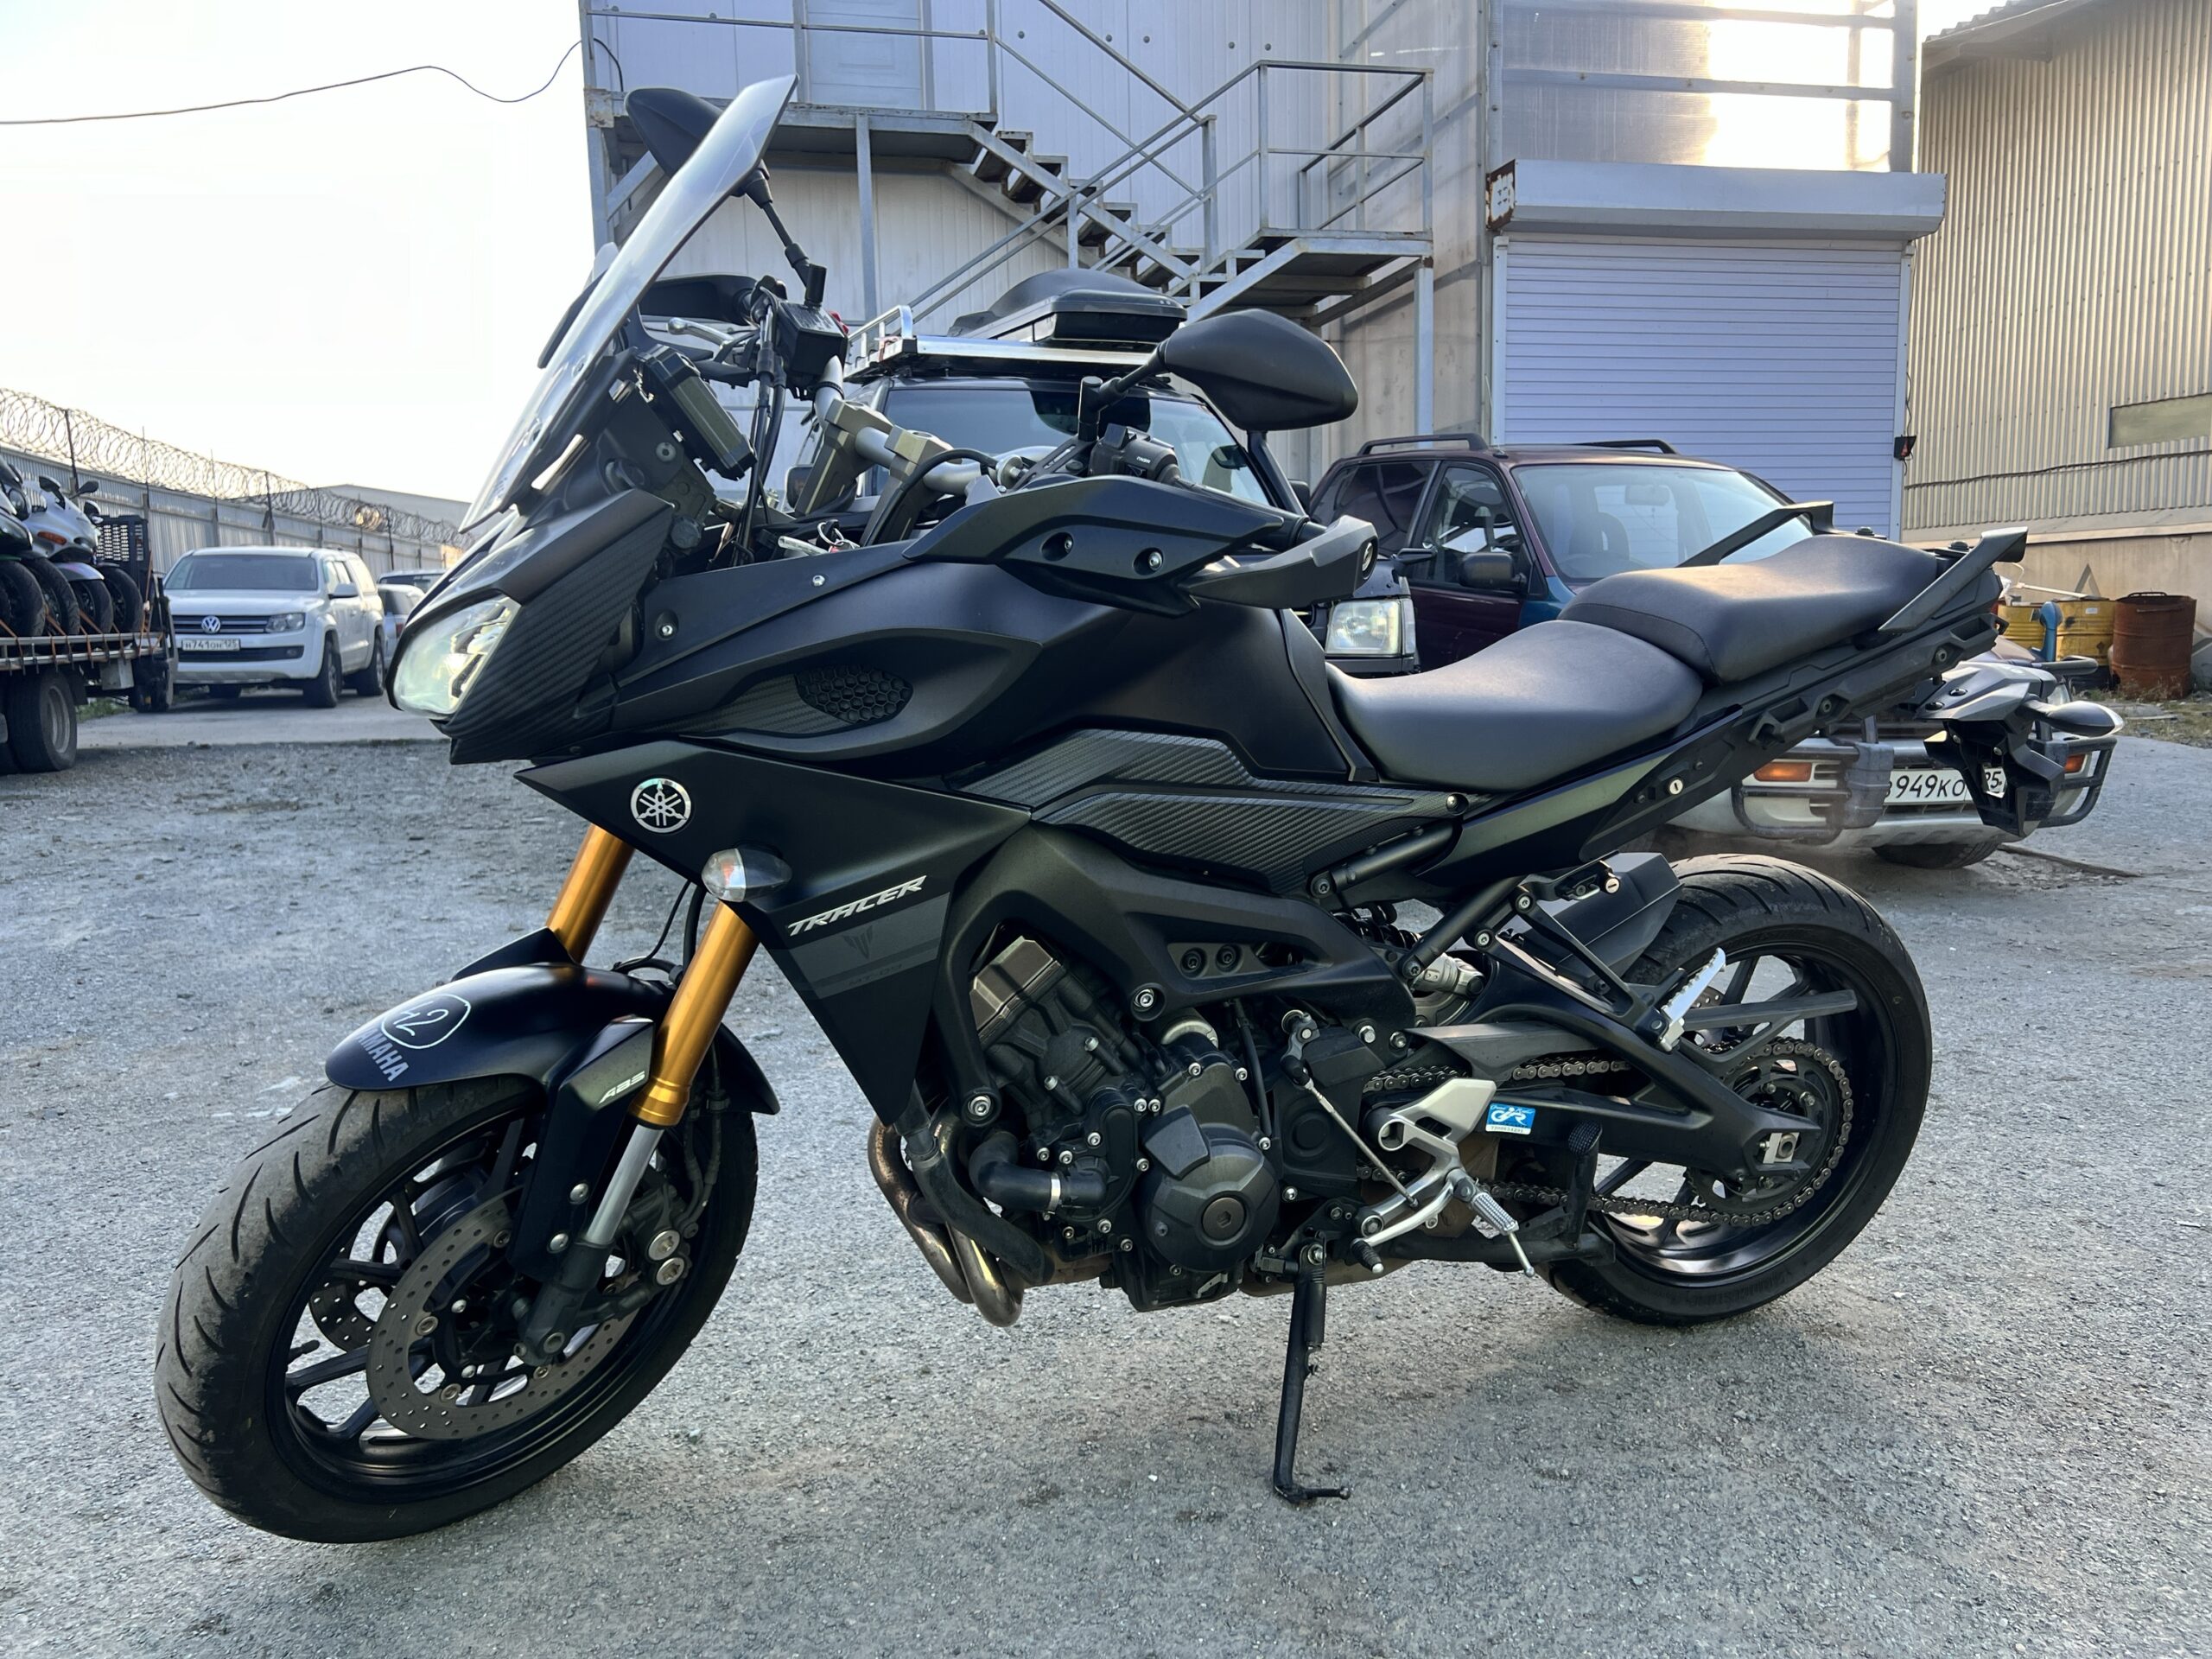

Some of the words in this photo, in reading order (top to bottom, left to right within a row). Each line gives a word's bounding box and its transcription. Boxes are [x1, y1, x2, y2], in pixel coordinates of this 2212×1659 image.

[787, 874, 927, 937] TRACER
[355, 1027, 410, 1082] AMAHA
[598, 1071, 645, 1104] ABS
